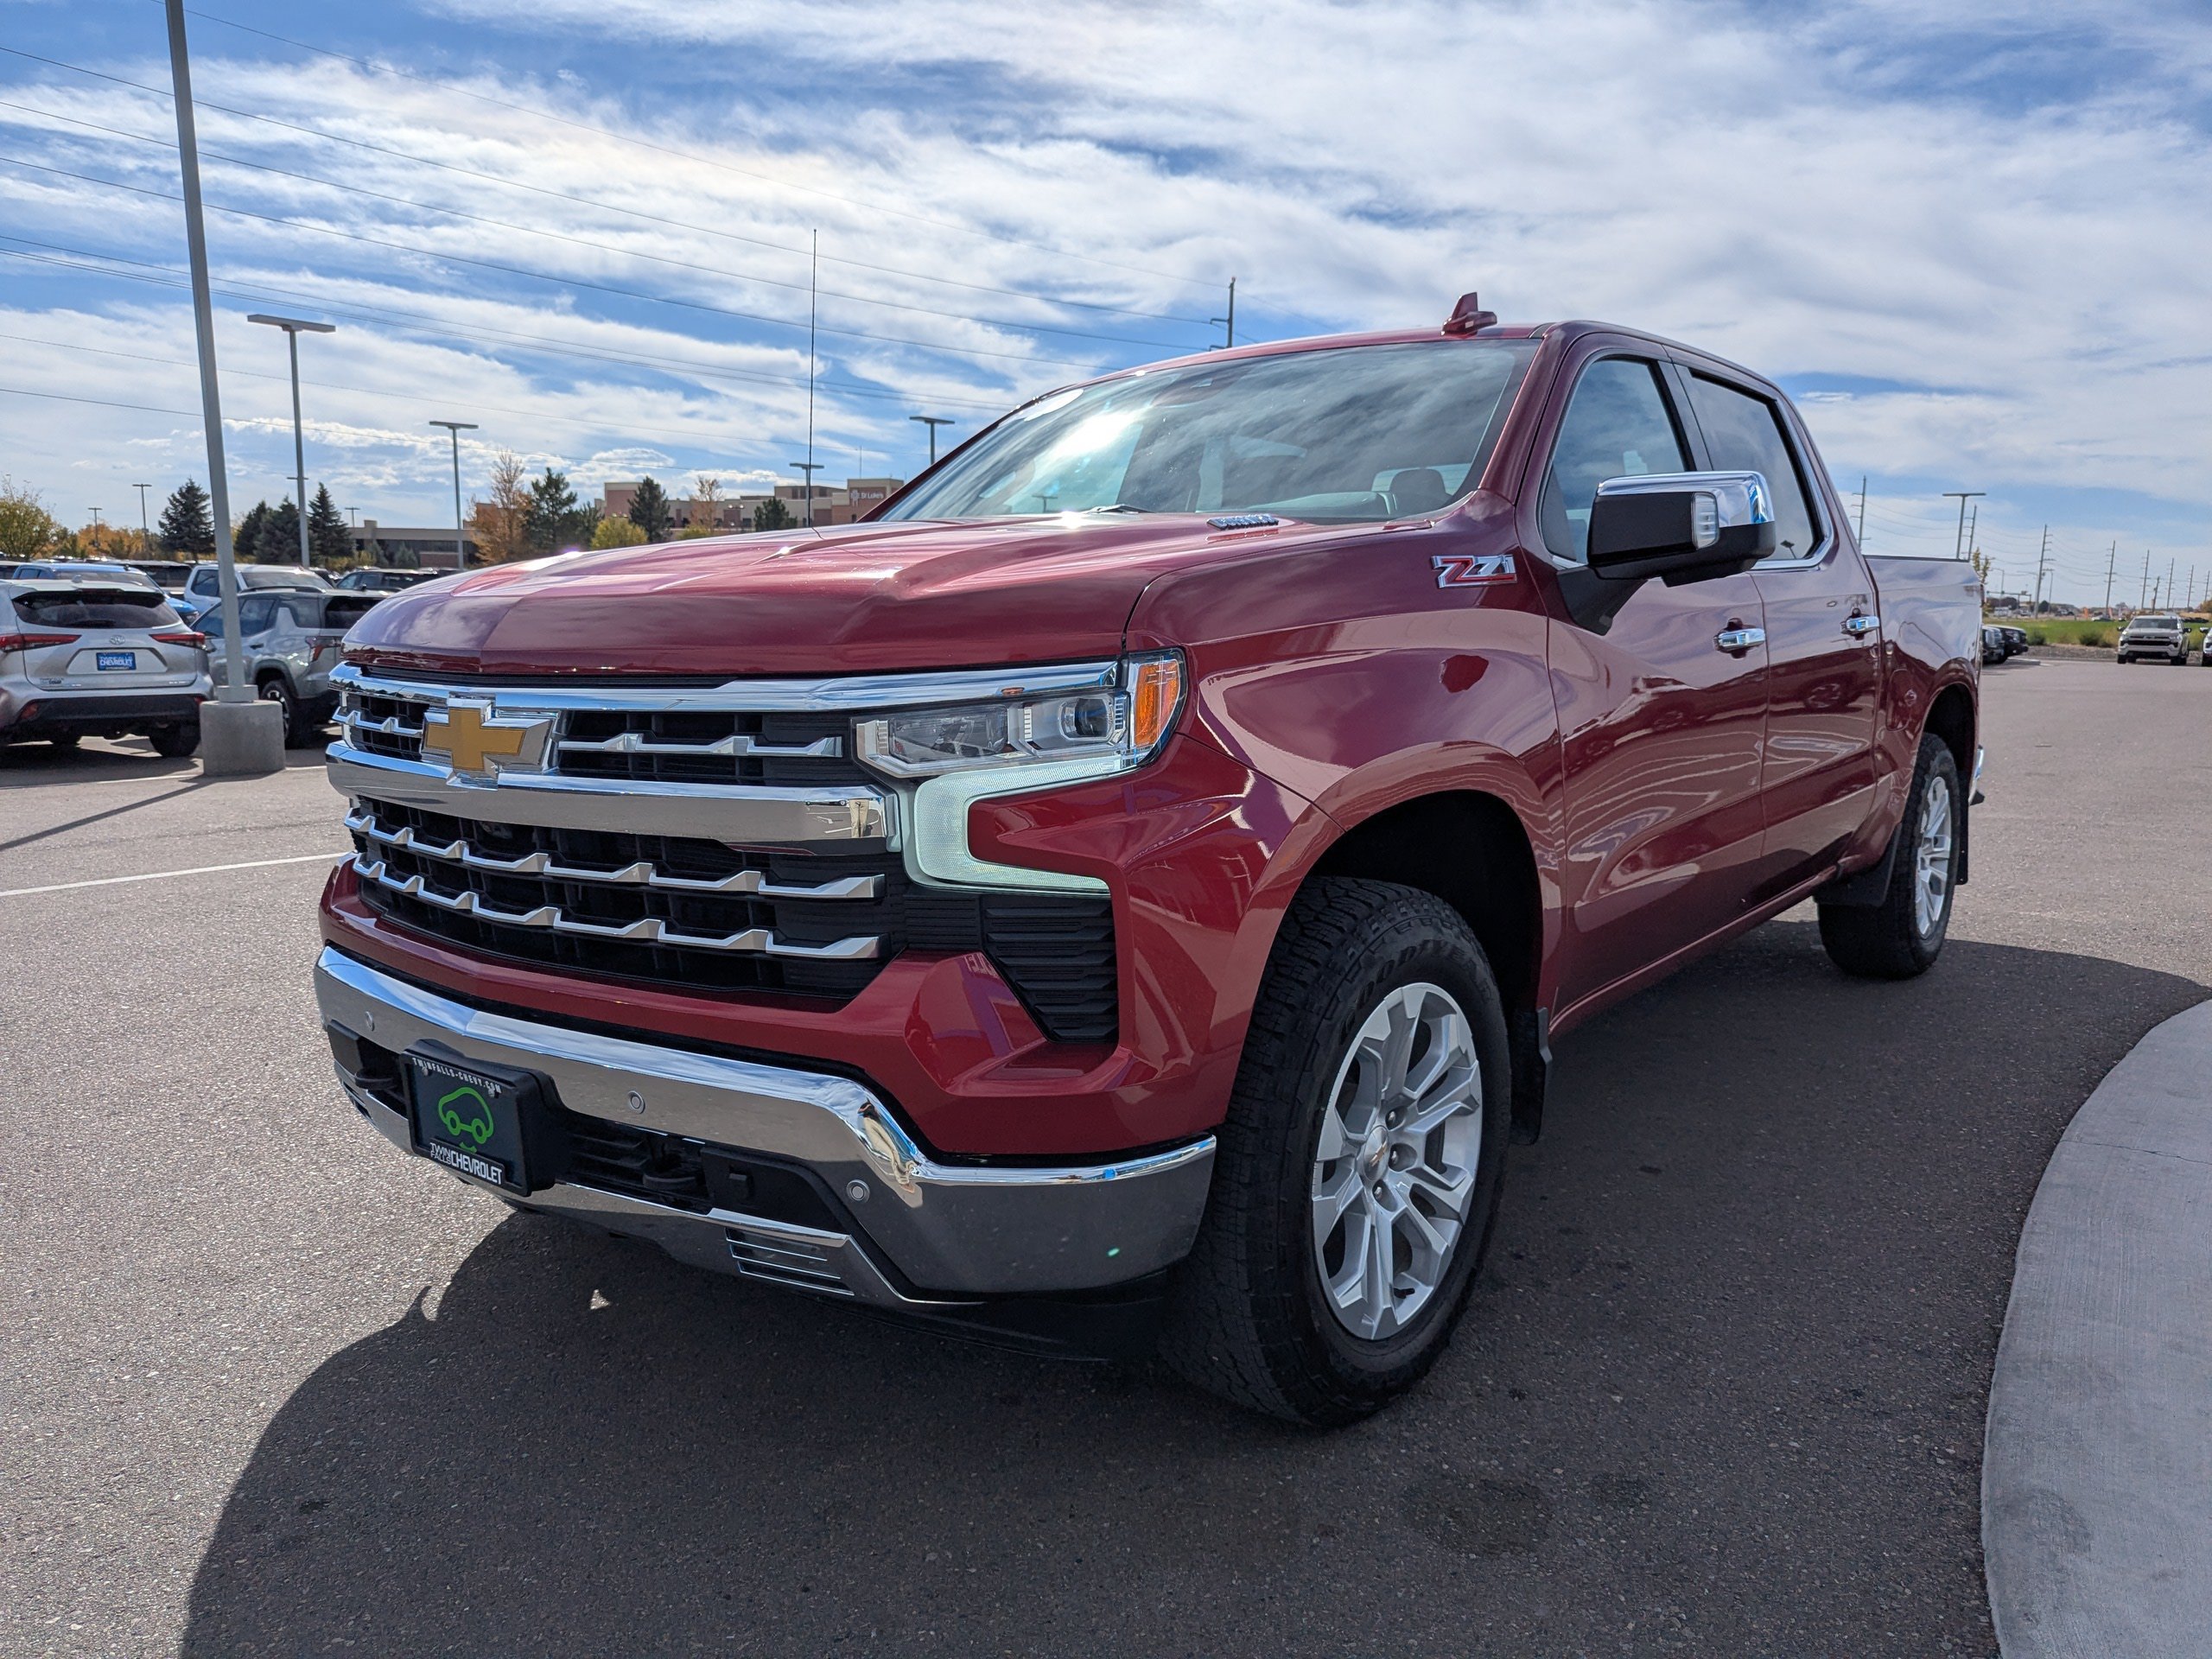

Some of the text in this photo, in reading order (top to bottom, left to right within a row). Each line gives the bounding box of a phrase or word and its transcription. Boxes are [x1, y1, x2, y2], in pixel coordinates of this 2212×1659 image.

[1431, 555, 1517, 588] Z71
[412, 1057, 502, 1094] TWINFALLS-CHEVY.COM
[429, 1142, 451, 1157] TWIN
[430, 1150, 452, 1165] FALLS
[450, 1150, 503, 1185] CHEVROLET
